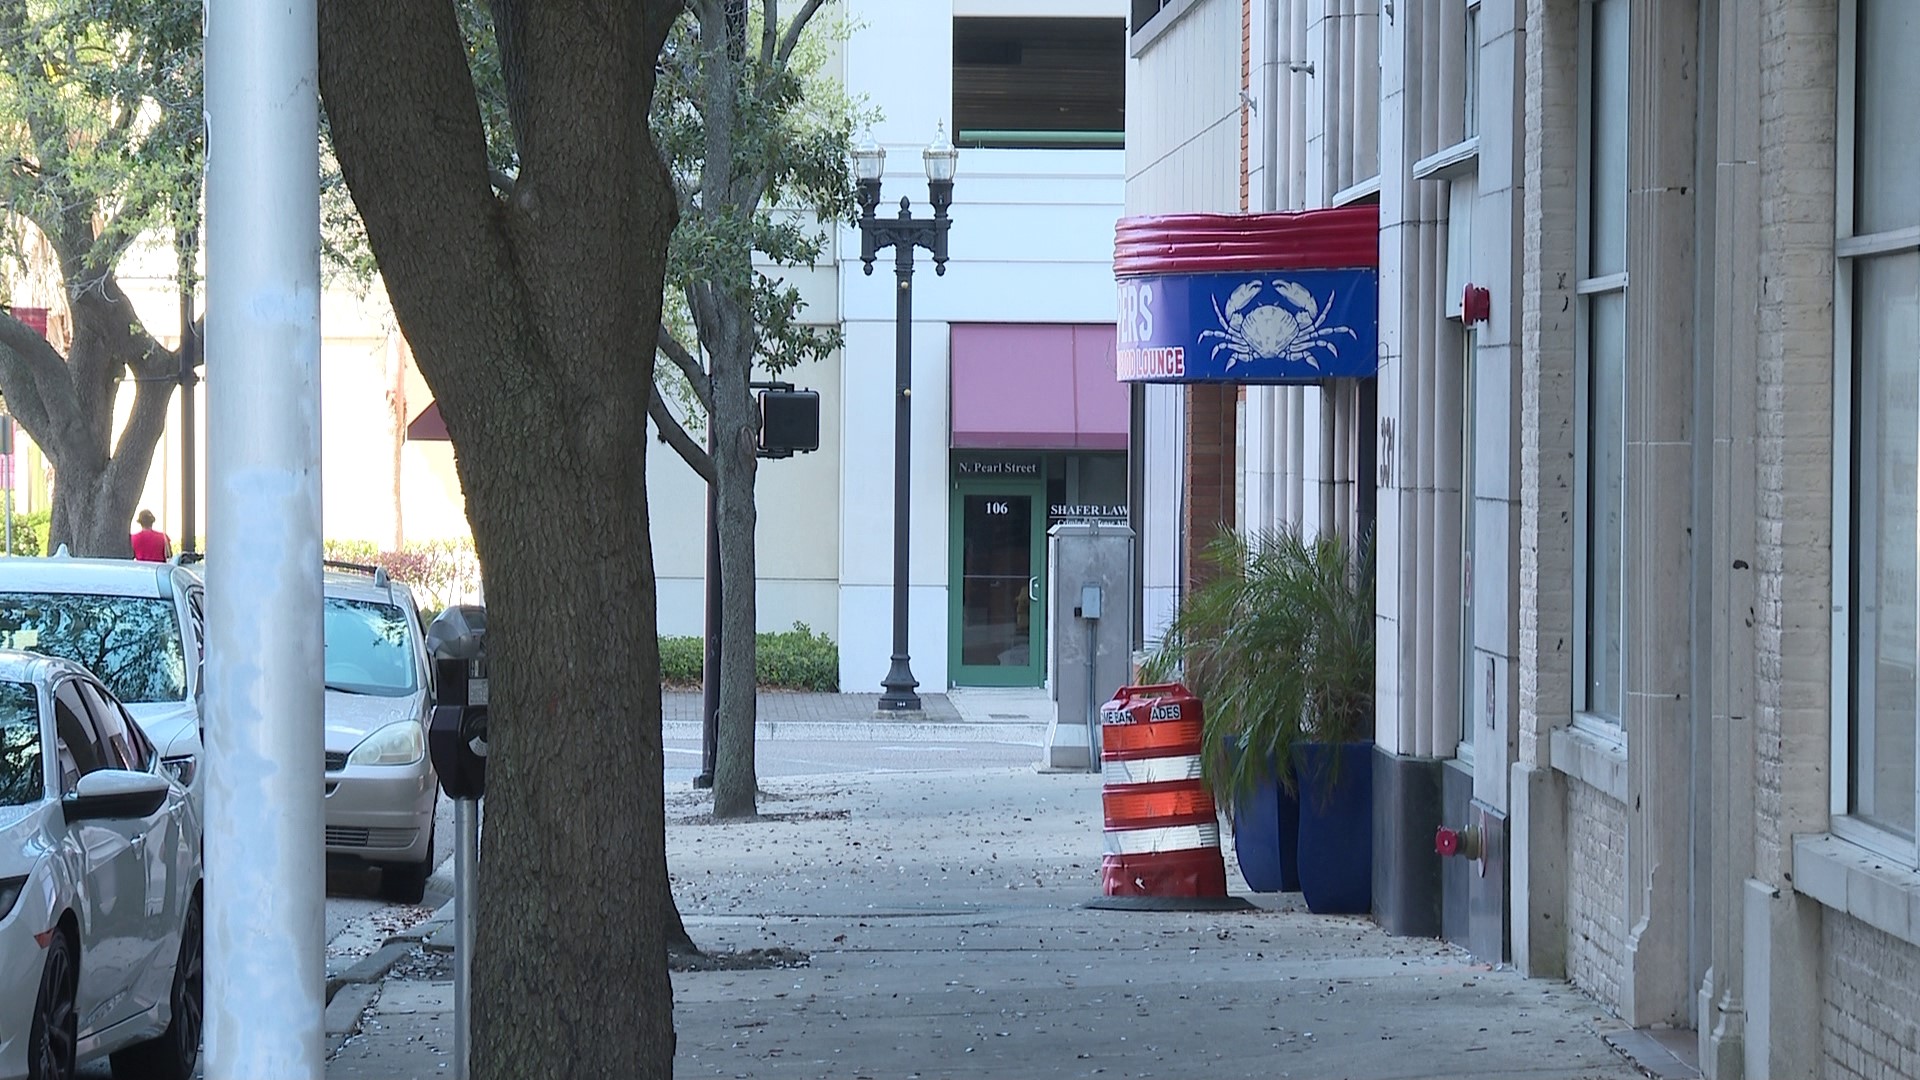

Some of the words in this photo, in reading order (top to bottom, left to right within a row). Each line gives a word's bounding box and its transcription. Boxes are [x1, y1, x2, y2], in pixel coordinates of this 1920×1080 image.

[1137, 348, 1184, 376] LOUNGE
[959, 462, 971, 473] N.
[974, 462, 1002, 473] Pearl
[1005, 462, 1036, 473] Street
[986, 502, 1008, 515] 106
[1050, 505, 1099, 516] SHAFER
[1102, 505, 1128, 516] LAW
